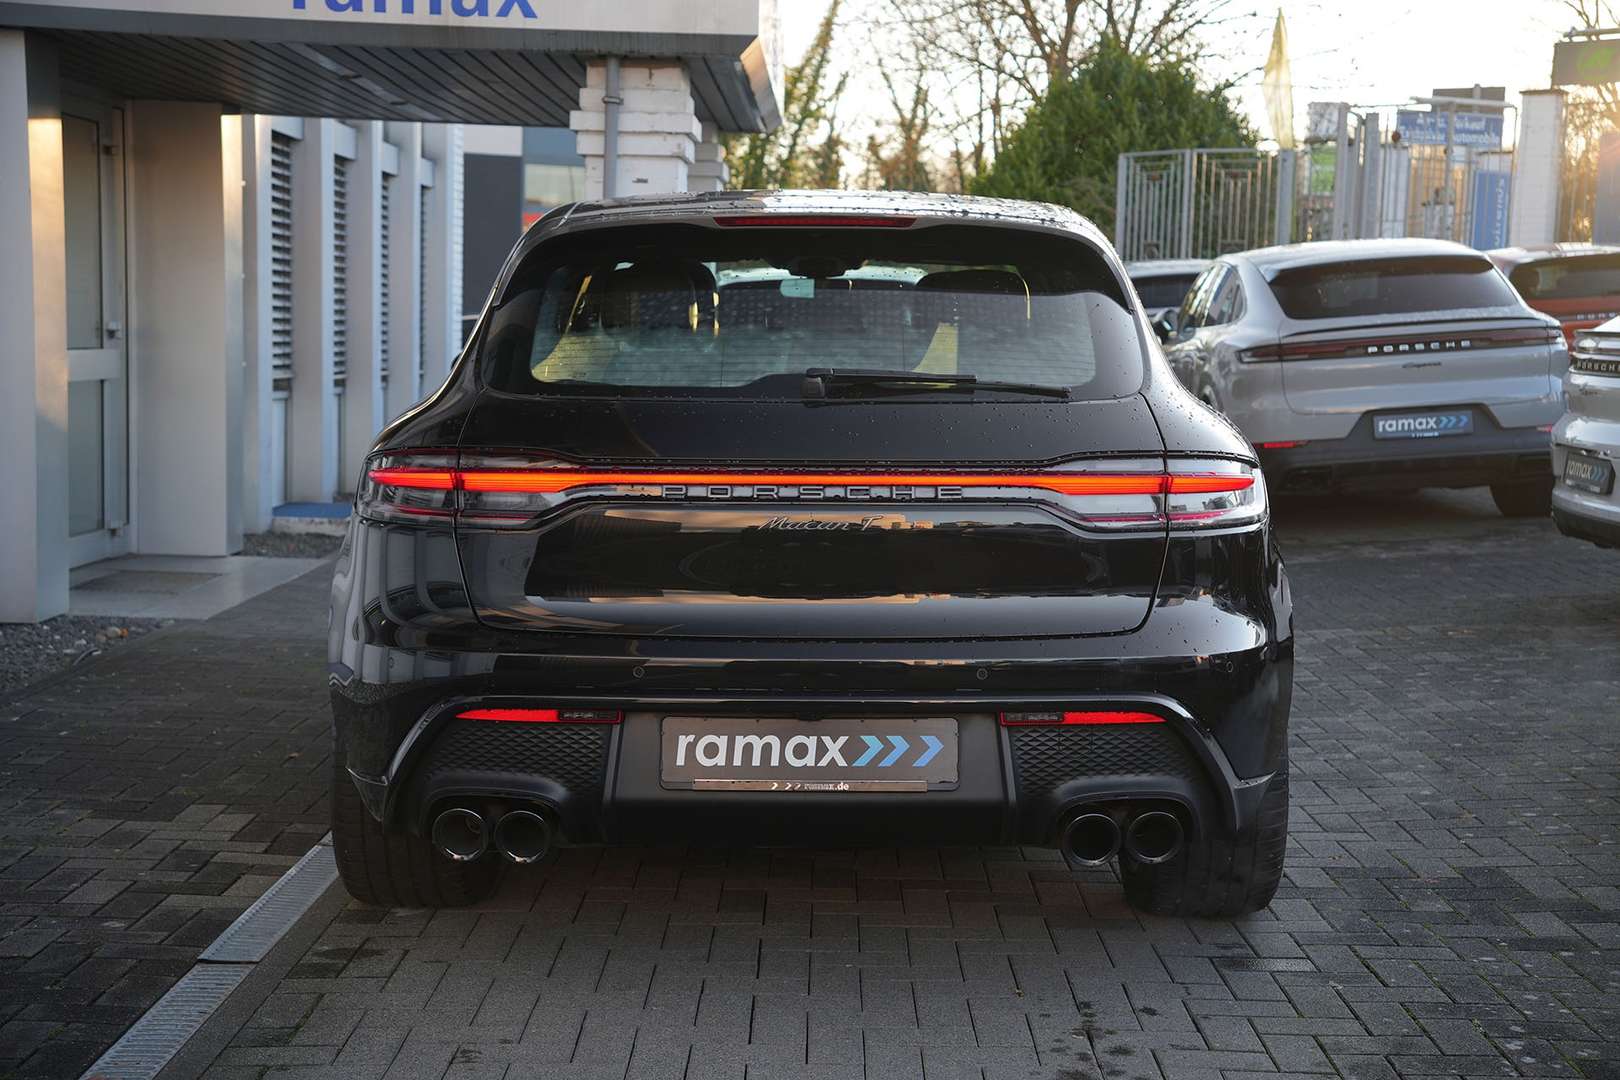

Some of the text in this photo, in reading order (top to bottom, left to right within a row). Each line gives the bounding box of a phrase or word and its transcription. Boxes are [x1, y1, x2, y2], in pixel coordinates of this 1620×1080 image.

[1367, 340, 1471, 353] PORSCHE
[1378, 416, 1437, 432] ramax
[661, 485, 964, 499] PORSCHE
[758, 514, 884, 531] Macan T
[675, 734, 849, 767] ramax
